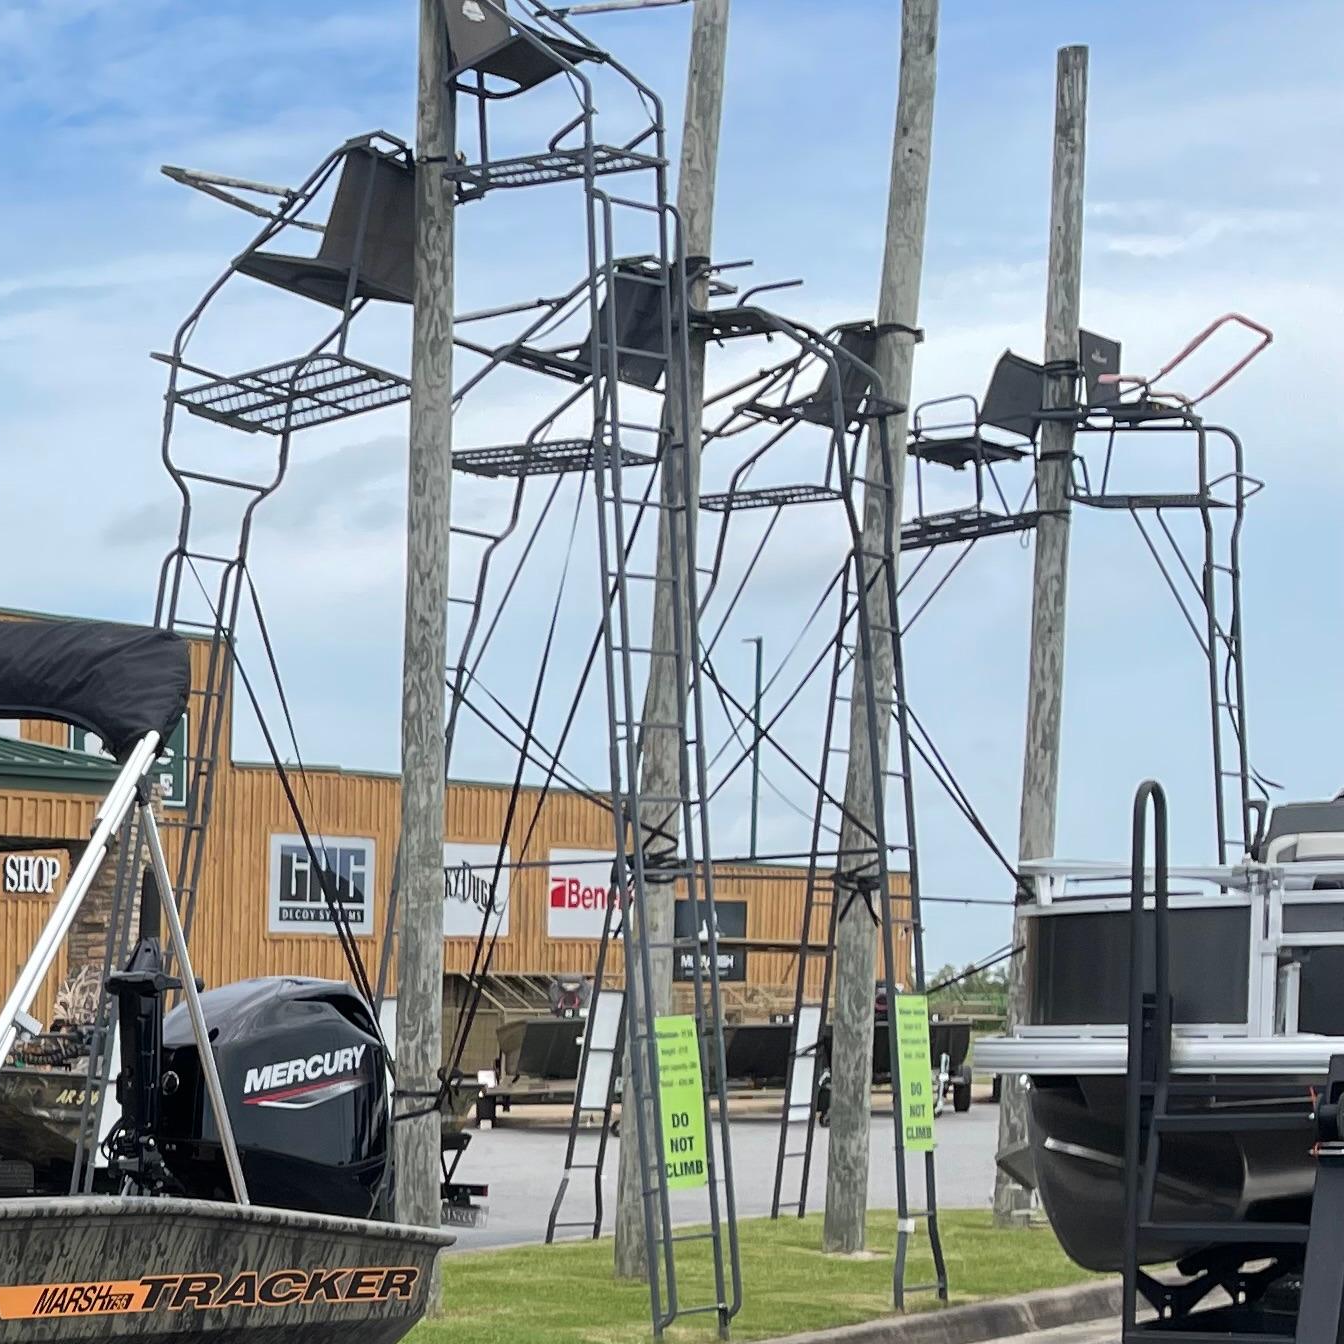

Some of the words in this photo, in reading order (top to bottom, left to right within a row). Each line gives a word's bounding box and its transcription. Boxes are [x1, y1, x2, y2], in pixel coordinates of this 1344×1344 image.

[5, 855, 60, 894] SHOP
[282, 908, 316, 921] DECOY
[244, 1044, 366, 1094] MERCURY
[911, 1082, 922, 1096] DO
[909, 1104, 925, 1117] NOT
[672, 1112, 689, 1128] DO
[906, 1126, 932, 1139] CLIMB
[670, 1136, 694, 1152] NOT
[666, 1160, 703, 1177] CLIMB
[32, 1285, 113, 1315] MARSH
[131, 1267, 420, 1312] TRACKER
